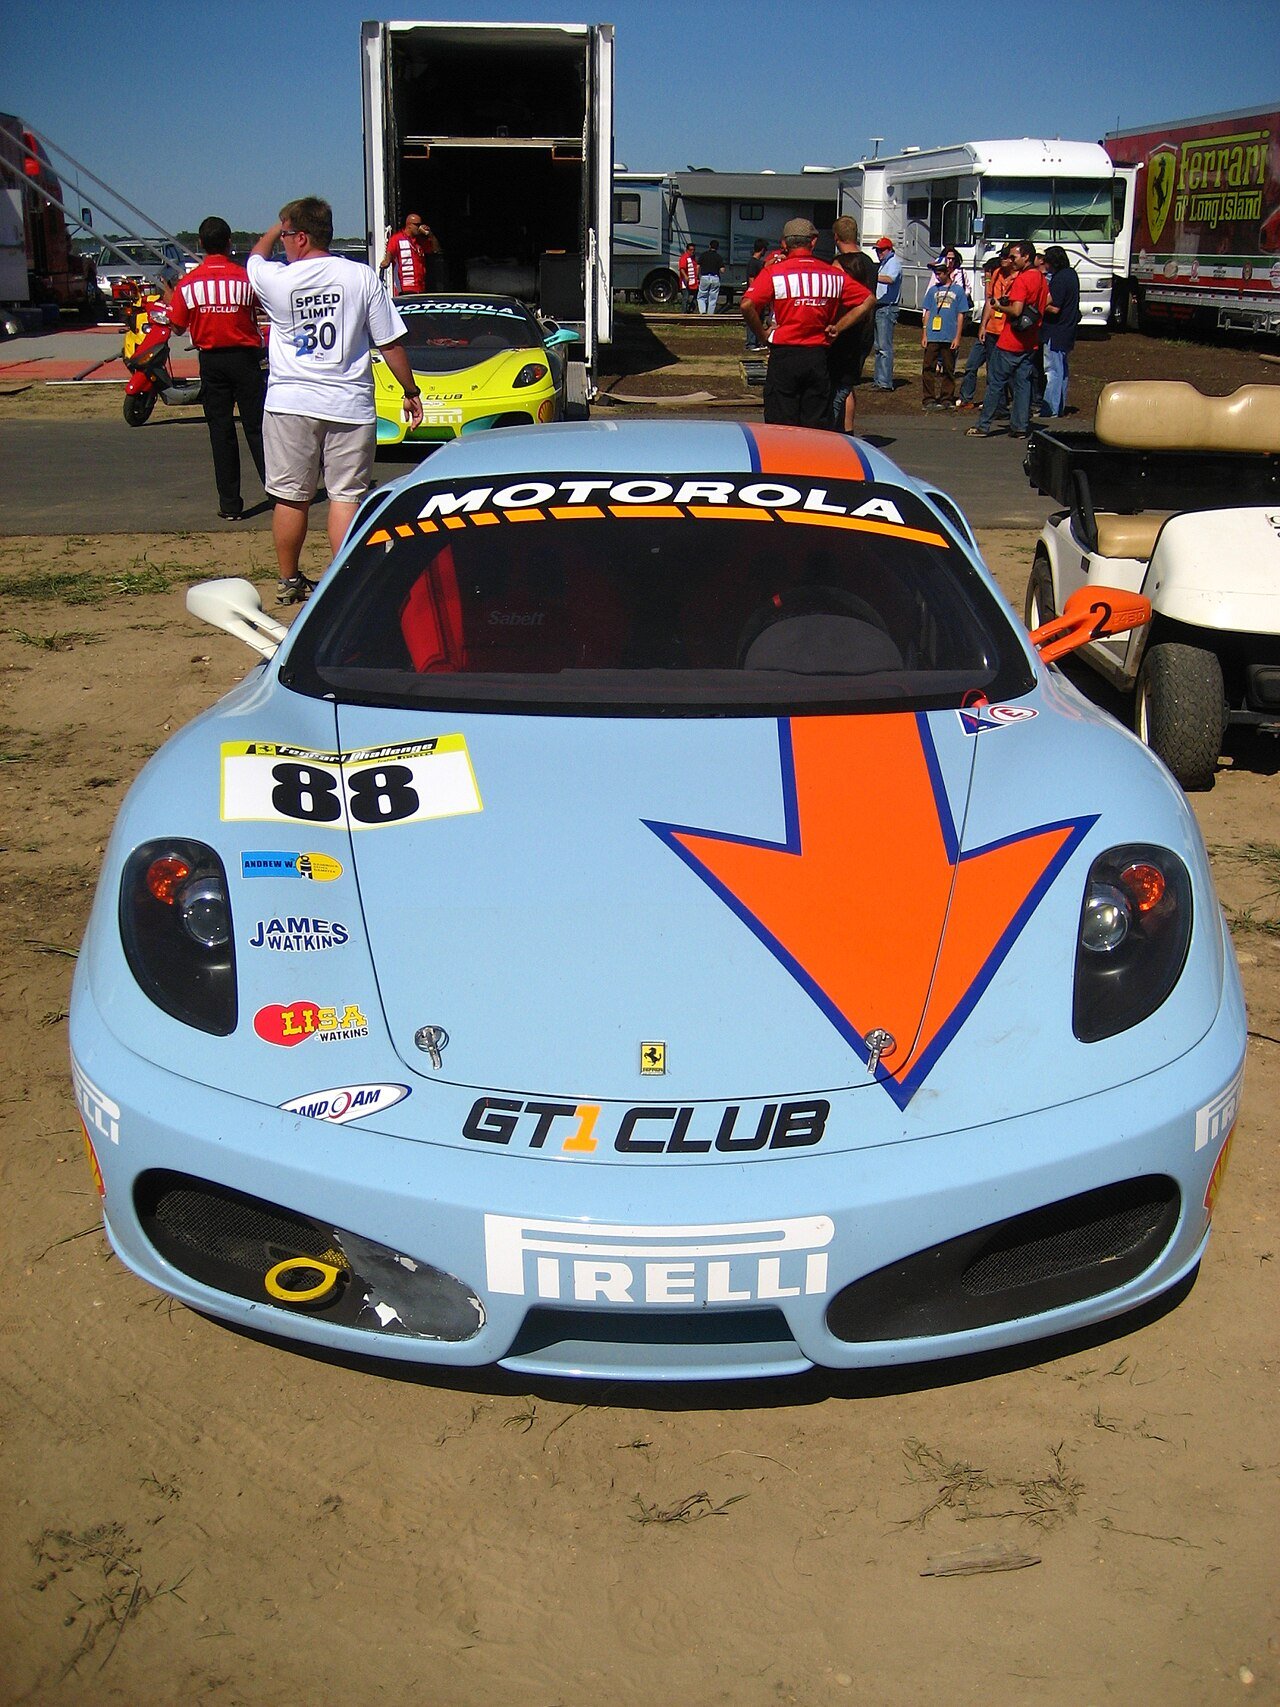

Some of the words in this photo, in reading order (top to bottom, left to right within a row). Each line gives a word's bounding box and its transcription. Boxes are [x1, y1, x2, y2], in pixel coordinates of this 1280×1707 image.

[1176, 130, 1270, 190] Ferrari
[1174, 195, 1188, 221] of
[295, 293, 341, 308] SPEED
[300, 306, 337, 320] LIMIT
[303, 322, 337, 351] 30
[417, 480, 905, 525] MOTOROLA
[1090, 601, 1112, 639] 2
[349, 741, 434, 764] Challenge
[272, 763, 420, 823] 88
[245, 860, 282, 868] ANDREW
[250, 917, 349, 947] JAMES
[282, 1005, 368, 1036] LISA
[320, 1027, 369, 1043] WATKINS
[351, 1089, 381, 1107] AM
[462, 1097, 601, 1153] GT1
[614, 1099, 830, 1154] CLUB
[484, 1213, 835, 1303] PIRELLI
